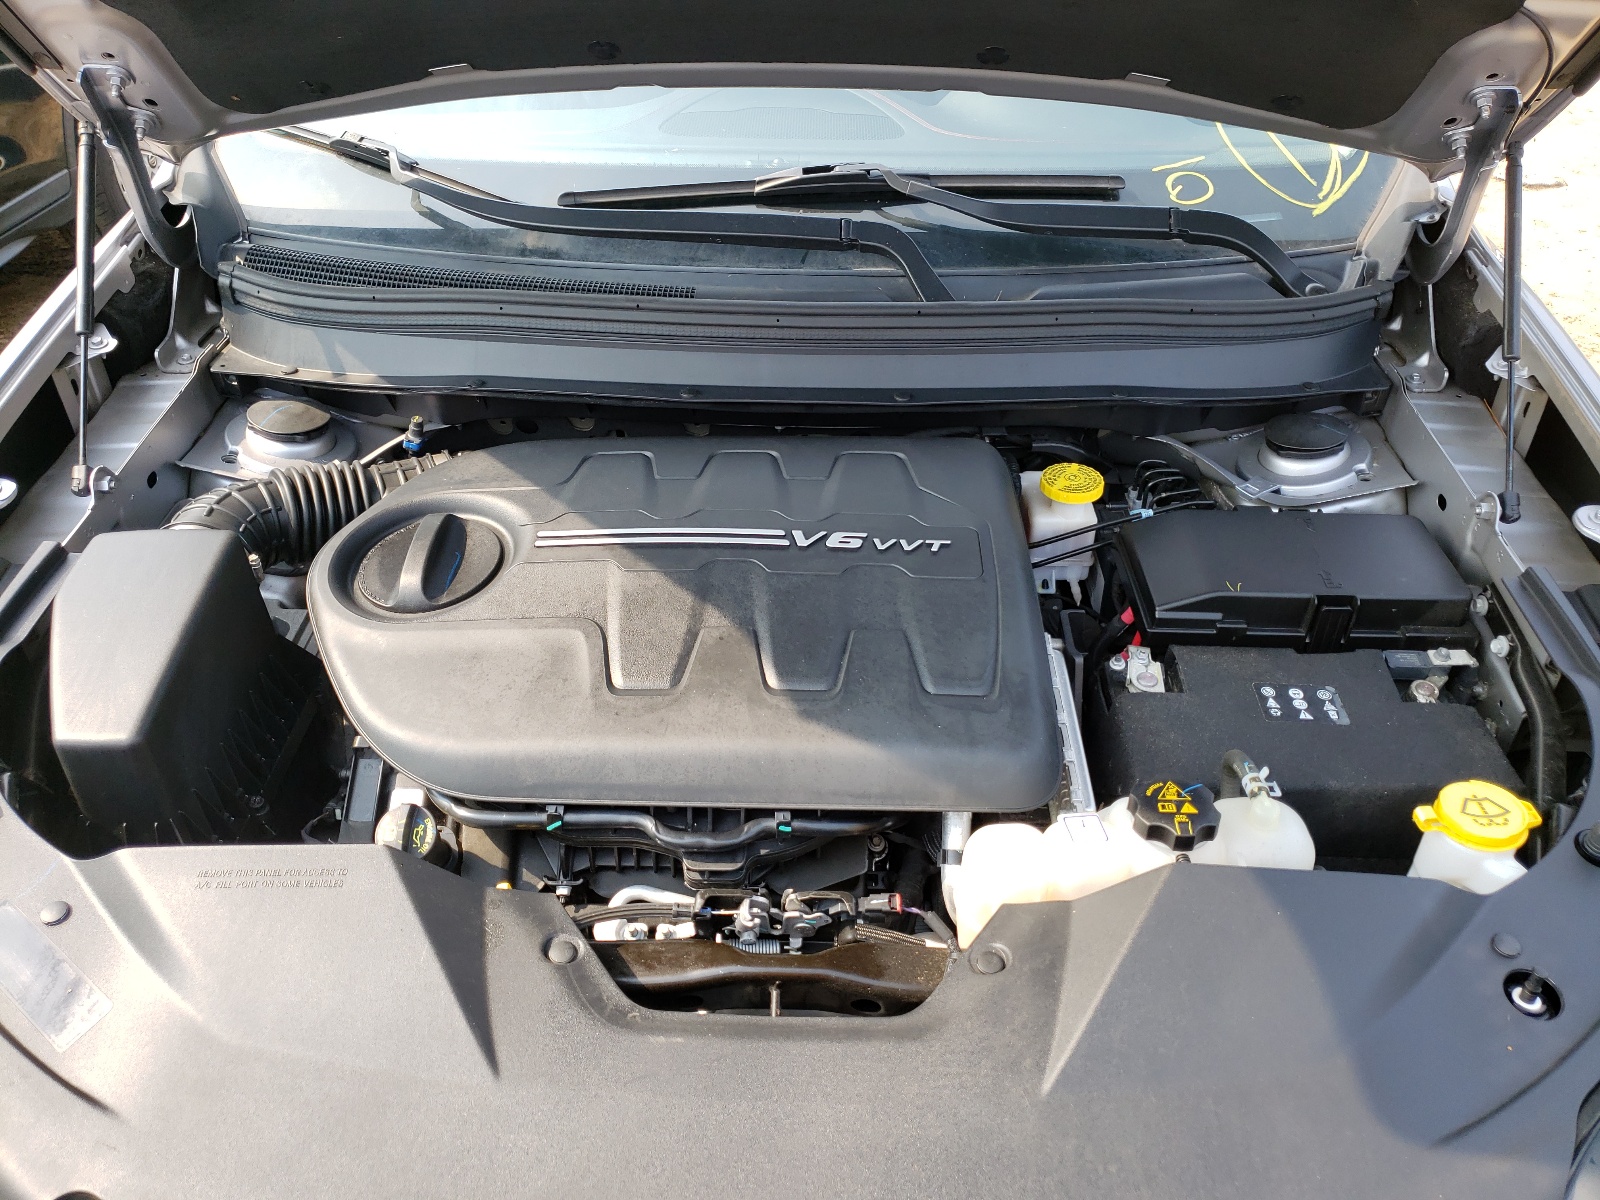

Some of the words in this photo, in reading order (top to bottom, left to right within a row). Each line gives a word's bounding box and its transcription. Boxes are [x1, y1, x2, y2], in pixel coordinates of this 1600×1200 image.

[791, 529, 868, 549] V6
[872, 537, 951, 552] VVT
[417, 843, 429, 854] OIL
[197, 869, 233, 878] REMOVE
[235, 869, 254, 878] THIS
[255, 868, 282, 877] PANEL
[283, 868, 301, 877] FOR
[302, 868, 336, 877] ACCESS
[337, 868, 349, 876] TO
[195, 880, 211, 889] A/C
[215, 880, 232, 889] FILL
[235, 880, 259, 889] PORT
[261, 880, 275, 888] ON
[276, 880, 301, 888] SOME
[303, 880, 344, 888] VEHICLES
